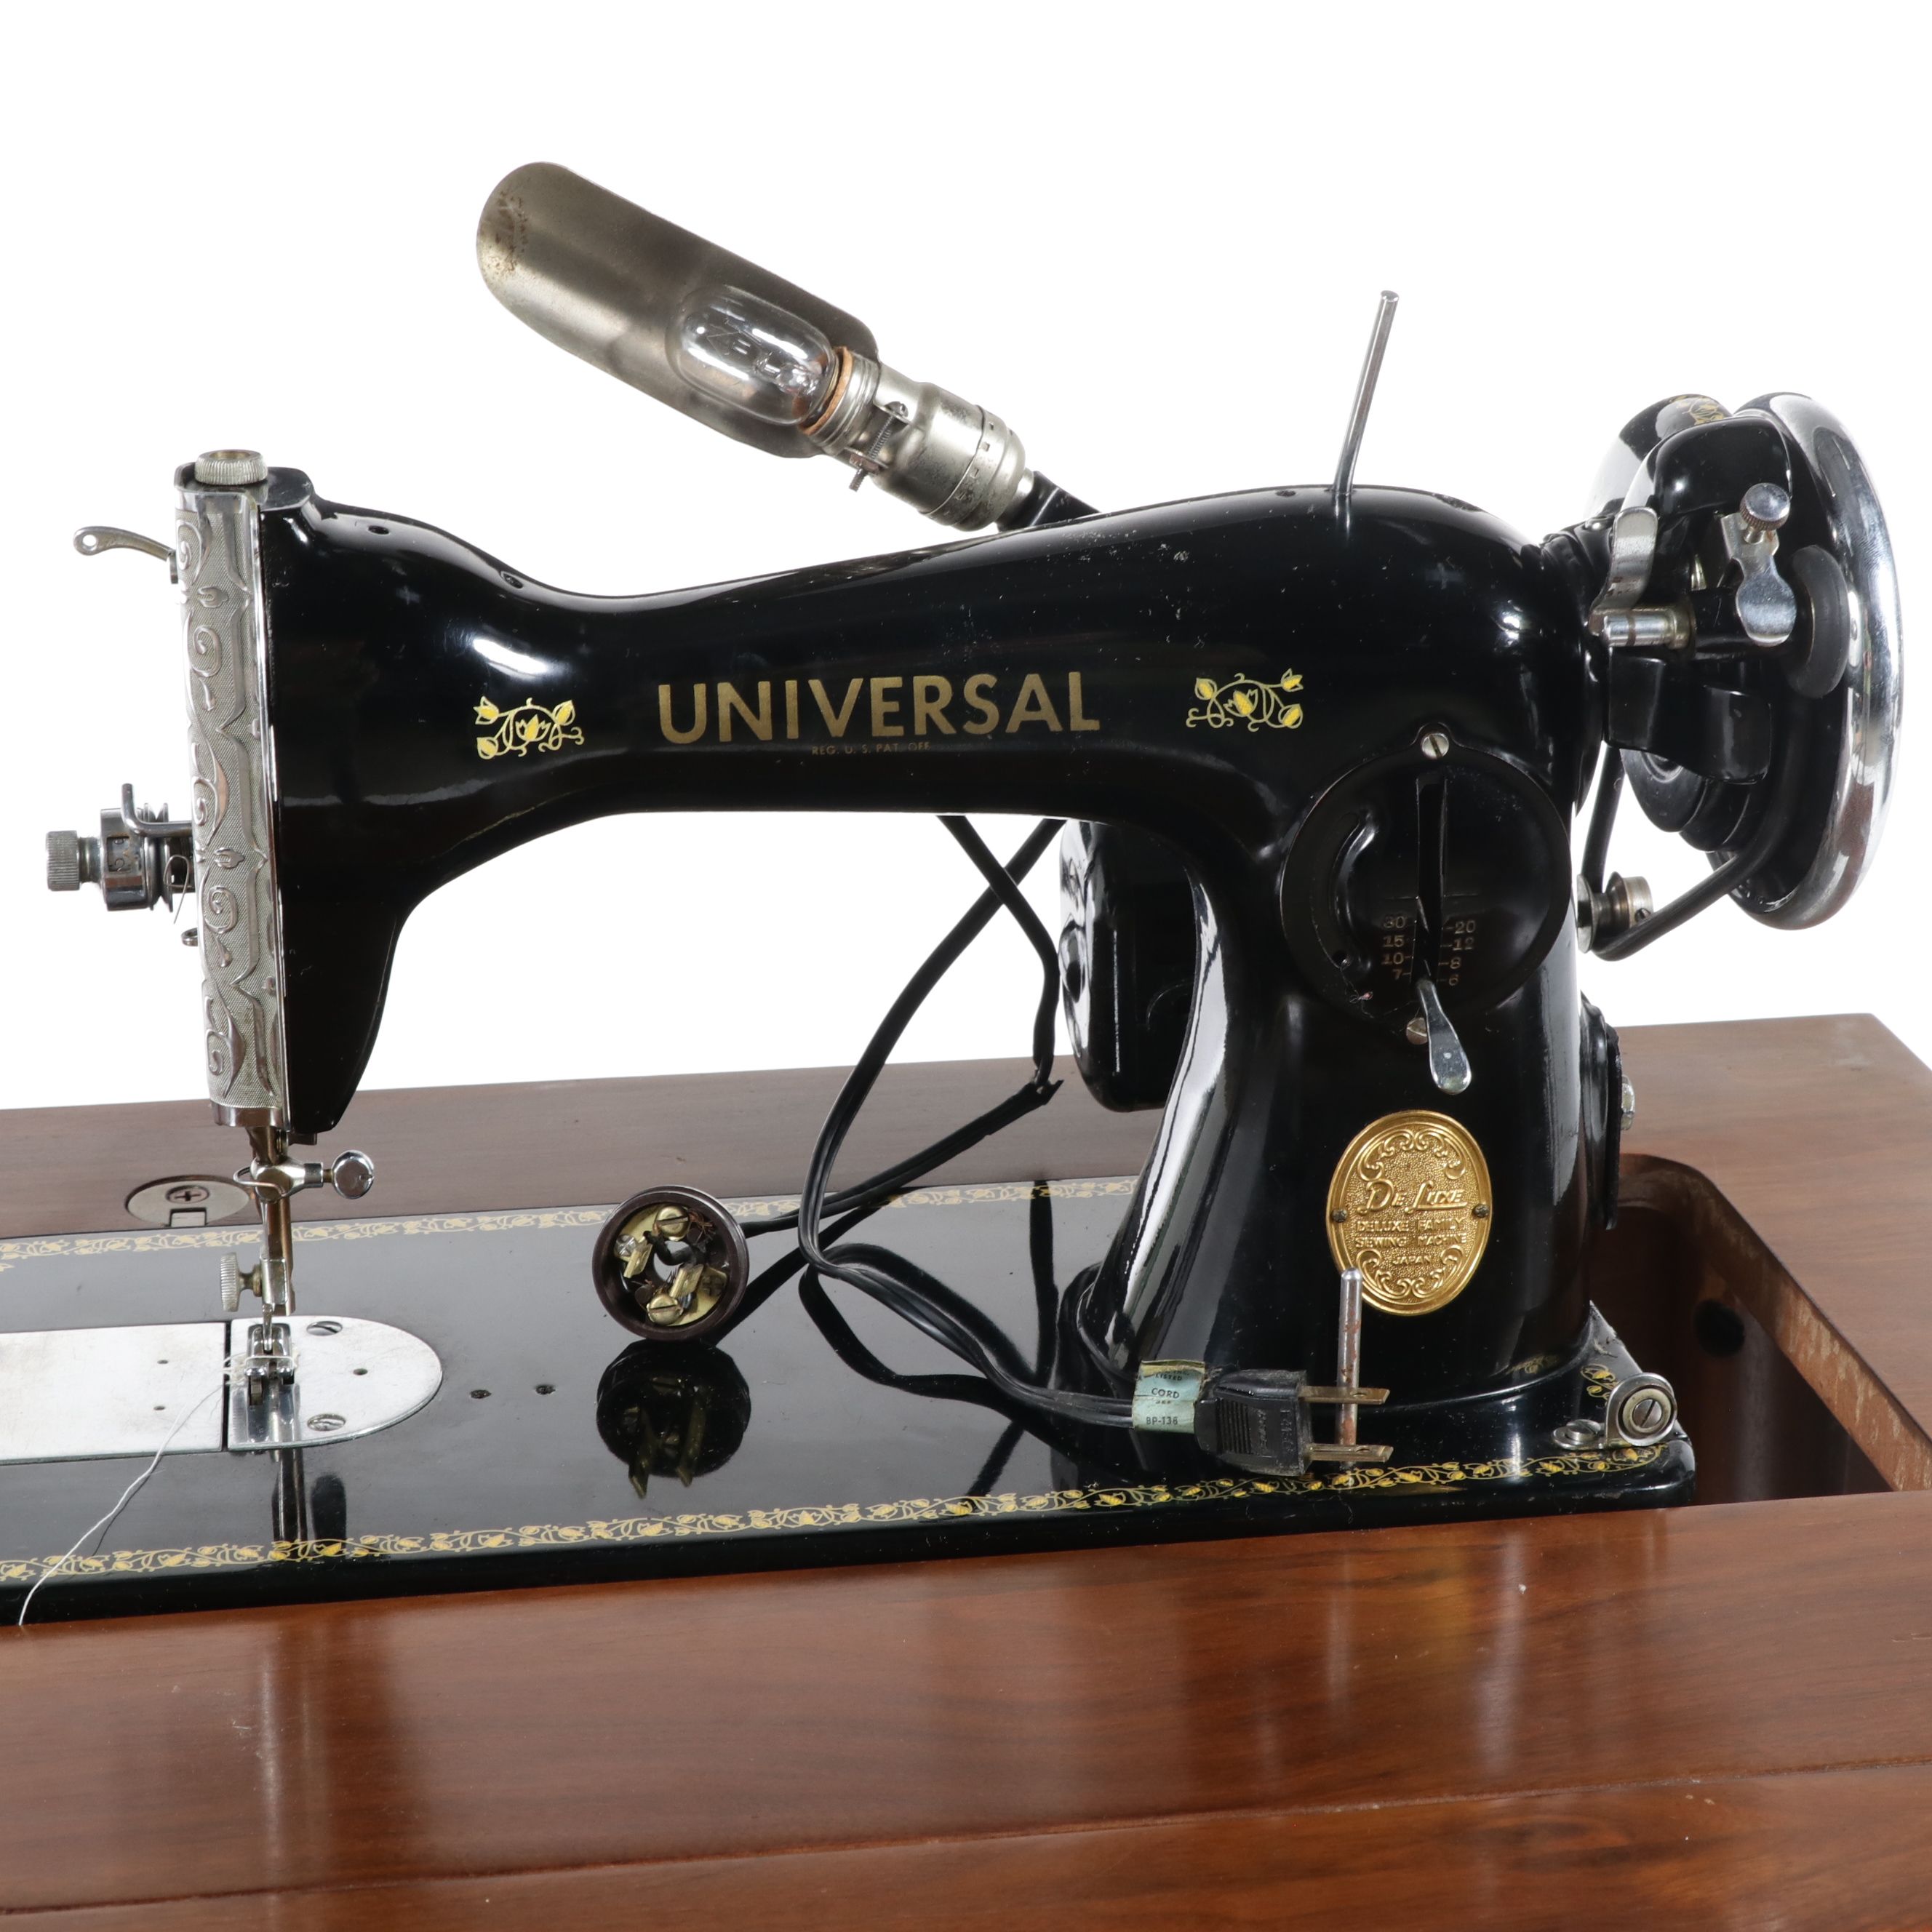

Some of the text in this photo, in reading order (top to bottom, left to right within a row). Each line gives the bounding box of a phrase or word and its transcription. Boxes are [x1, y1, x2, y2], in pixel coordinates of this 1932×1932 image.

[658, 668, 1101, 744] UNIVERSAL
[812, 745, 839, 755] REG.
[845, 745, 856, 754] U.
[861, 743, 871, 754] S.
[1455, 919, 1476, 934] 20
[1382, 935, 1405, 947] 15
[1453, 937, 1474, 951] 12
[1381, 952, 1405, 965] 10
[1450, 957, 1461, 969] 8
[1392, 969, 1402, 980] 7
[1448, 974, 1459, 986] 6
[1357, 1218, 1465, 1232] DELUXE FAMILY
[1355, 1233, 1467, 1248] SEWING MACHINE
[1392, 1255, 1432, 1265] JAPAN
[1151, 1387, 1180, 1398] CORD
